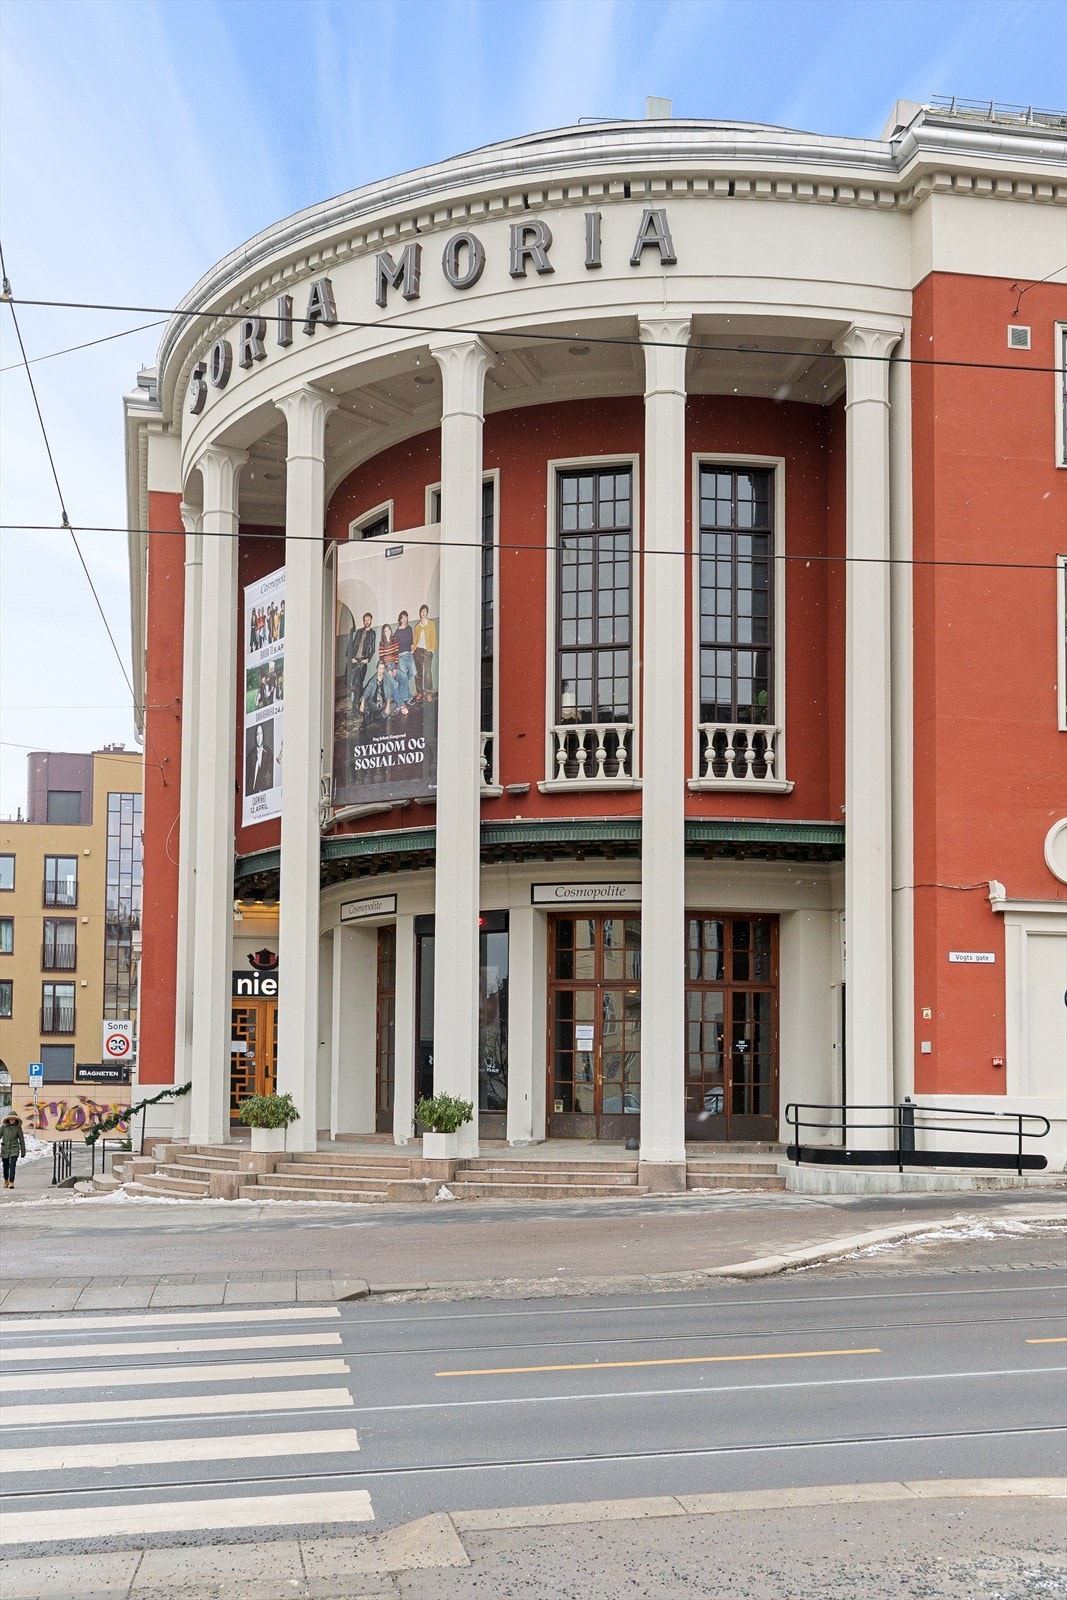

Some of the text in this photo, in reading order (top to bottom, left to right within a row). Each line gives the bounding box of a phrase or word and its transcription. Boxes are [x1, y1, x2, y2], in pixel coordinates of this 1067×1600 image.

[189, 208, 678, 416] SORIA MORIA
[353, 737, 426, 758] SYKDOM OG
[354, 751, 424, 771] SOSIAL NØD
[554, 885, 626, 900] Cosmopolite
[348, 900, 383, 915] Cosmopolite
[955, 953, 990, 962] Vogts gate
[237, 971, 278, 996] nie
[107, 1022, 129, 1031] Sone
[110, 1039, 126, 1051] 30
[32, 1064, 40, 1075] P
